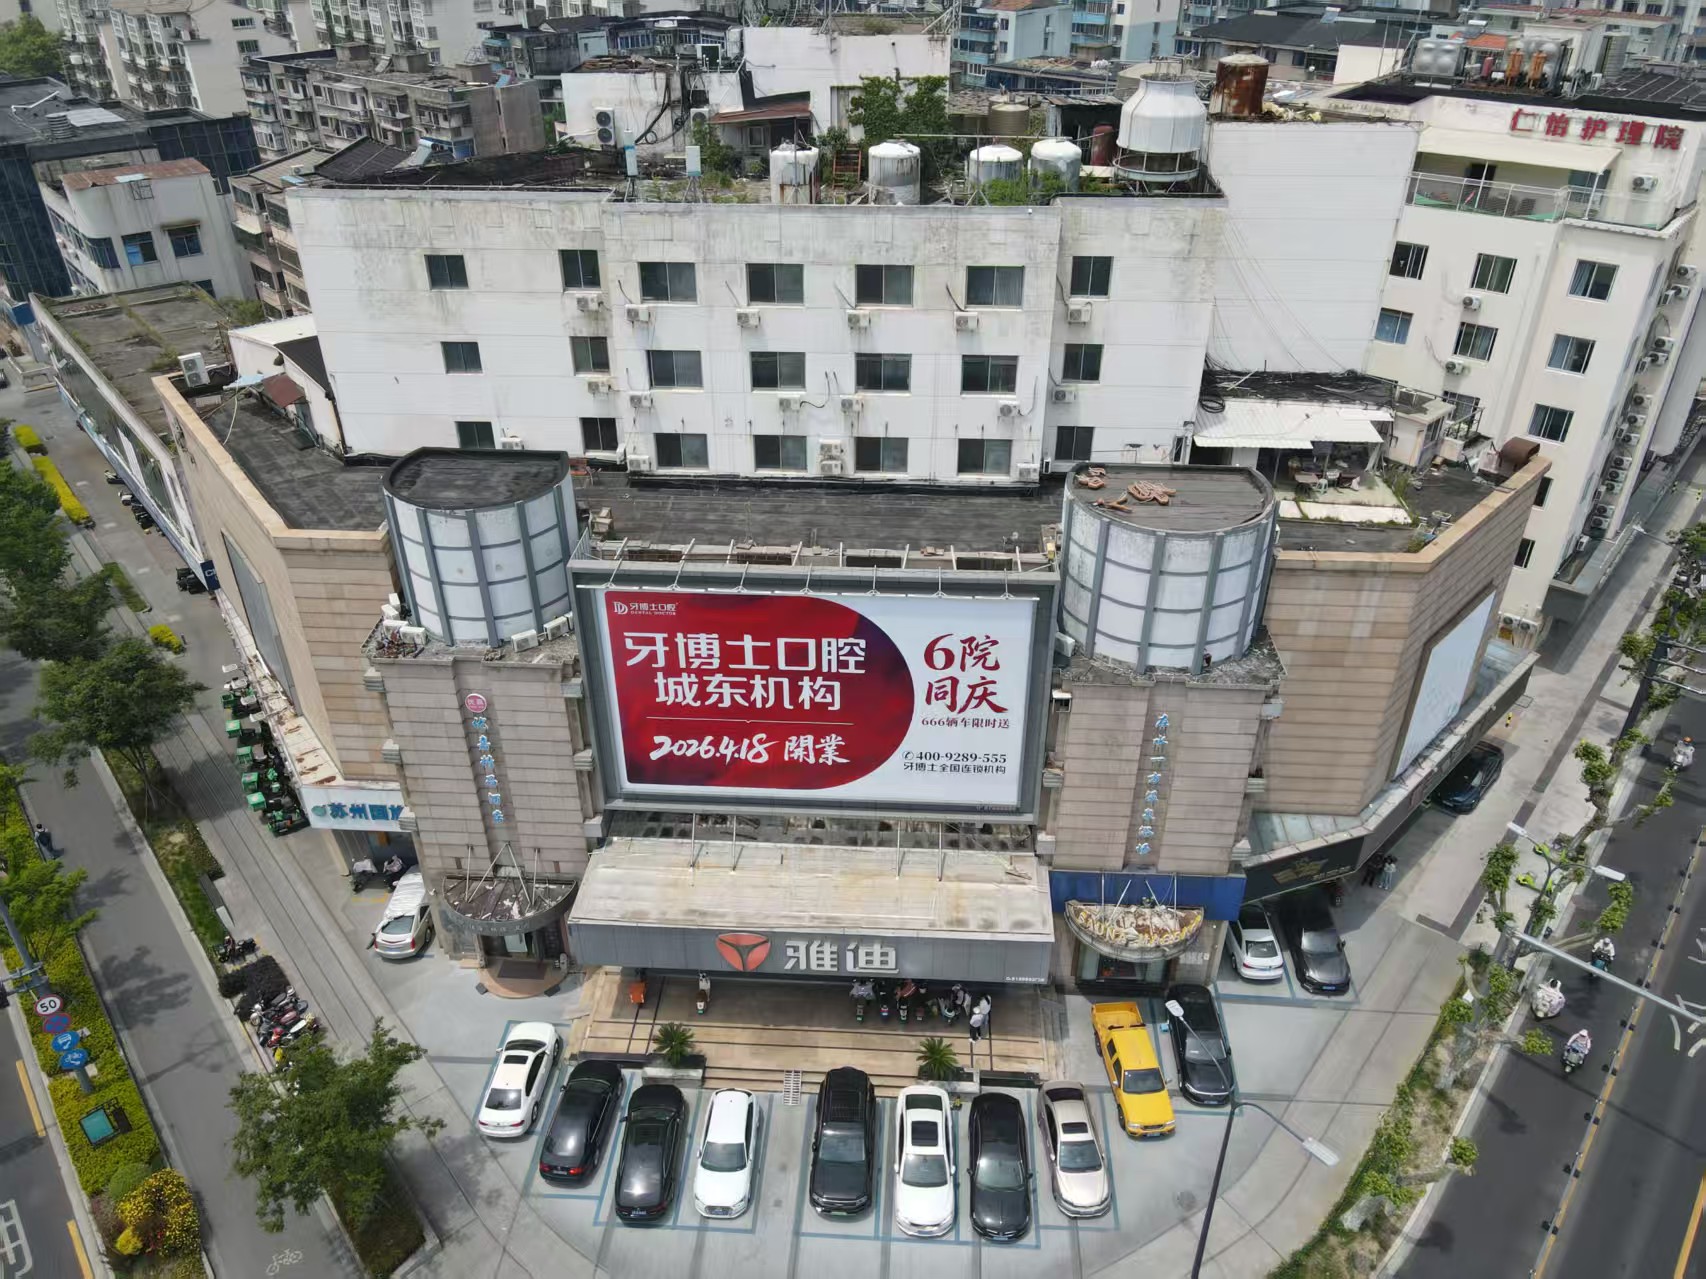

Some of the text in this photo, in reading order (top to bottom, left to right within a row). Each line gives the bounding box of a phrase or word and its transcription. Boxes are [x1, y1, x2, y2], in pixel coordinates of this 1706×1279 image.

[1511, 108, 1685, 150] 仁怡护理院
[630, 602, 676, 611] 牙博士口腔
[624, 632, 866, 674] 牙博士口腔
[924, 633, 1000, 672] 6院
[654, 672, 841, 711] 城东机构
[925, 676, 1008, 714] 同庆
[921, 717, 1009, 729] 666辆车限时送
[650, 733, 850, 766] 2026.4.18 開業
[916, 751, 1007, 764] 400-9289-555
[903, 762, 1006, 774] 牙博士全国连锁机构
[783, 939, 900, 974] 雅迪
[40, 999, 57, 1013] 50
